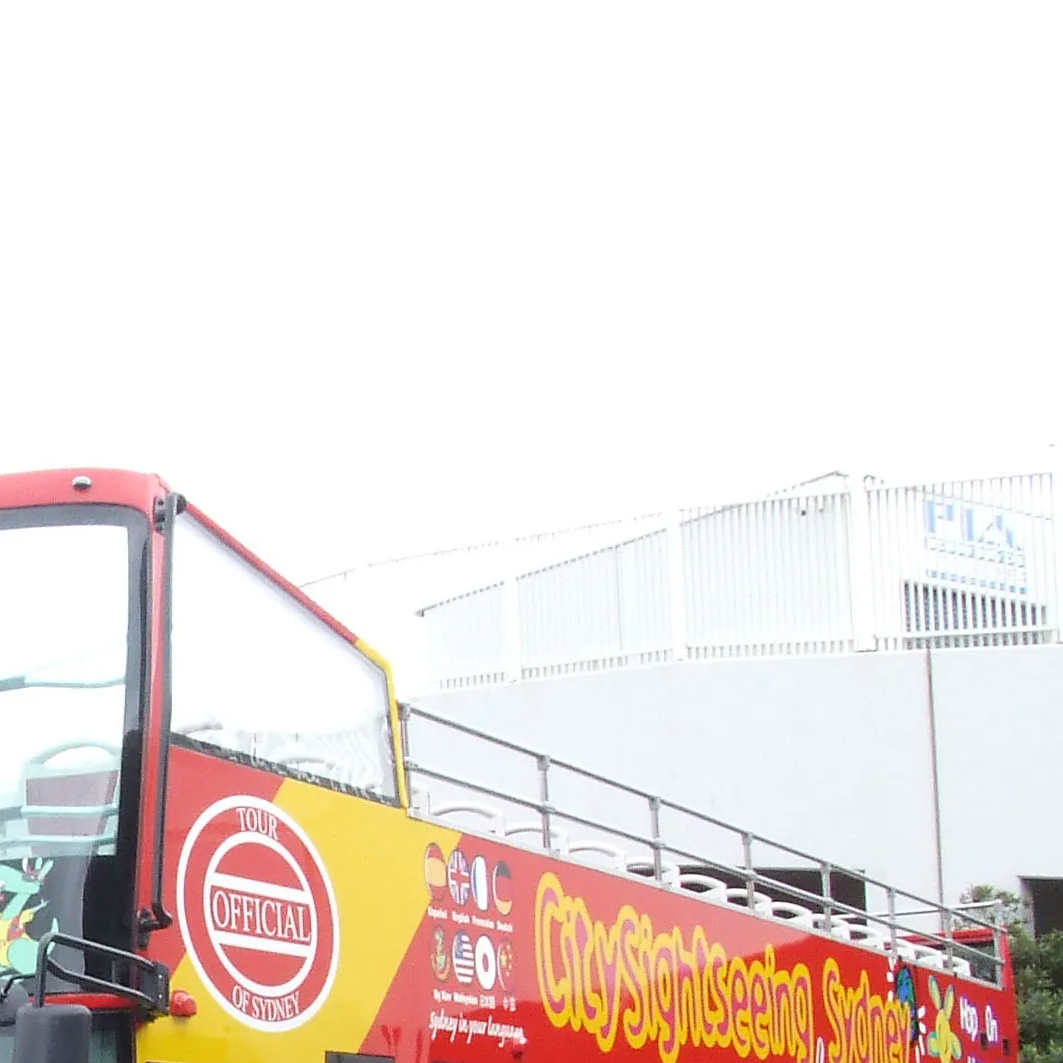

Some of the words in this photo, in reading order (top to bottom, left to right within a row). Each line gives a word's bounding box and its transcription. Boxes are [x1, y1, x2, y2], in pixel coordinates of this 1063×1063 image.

[236, 808, 279, 841] TOUR
[213, 890, 312, 942] OFFICIAL
[232, 986, 249, 1012] OF
[253, 992, 300, 1022] SYDNEY
[959, 995, 979, 1043] Hop
